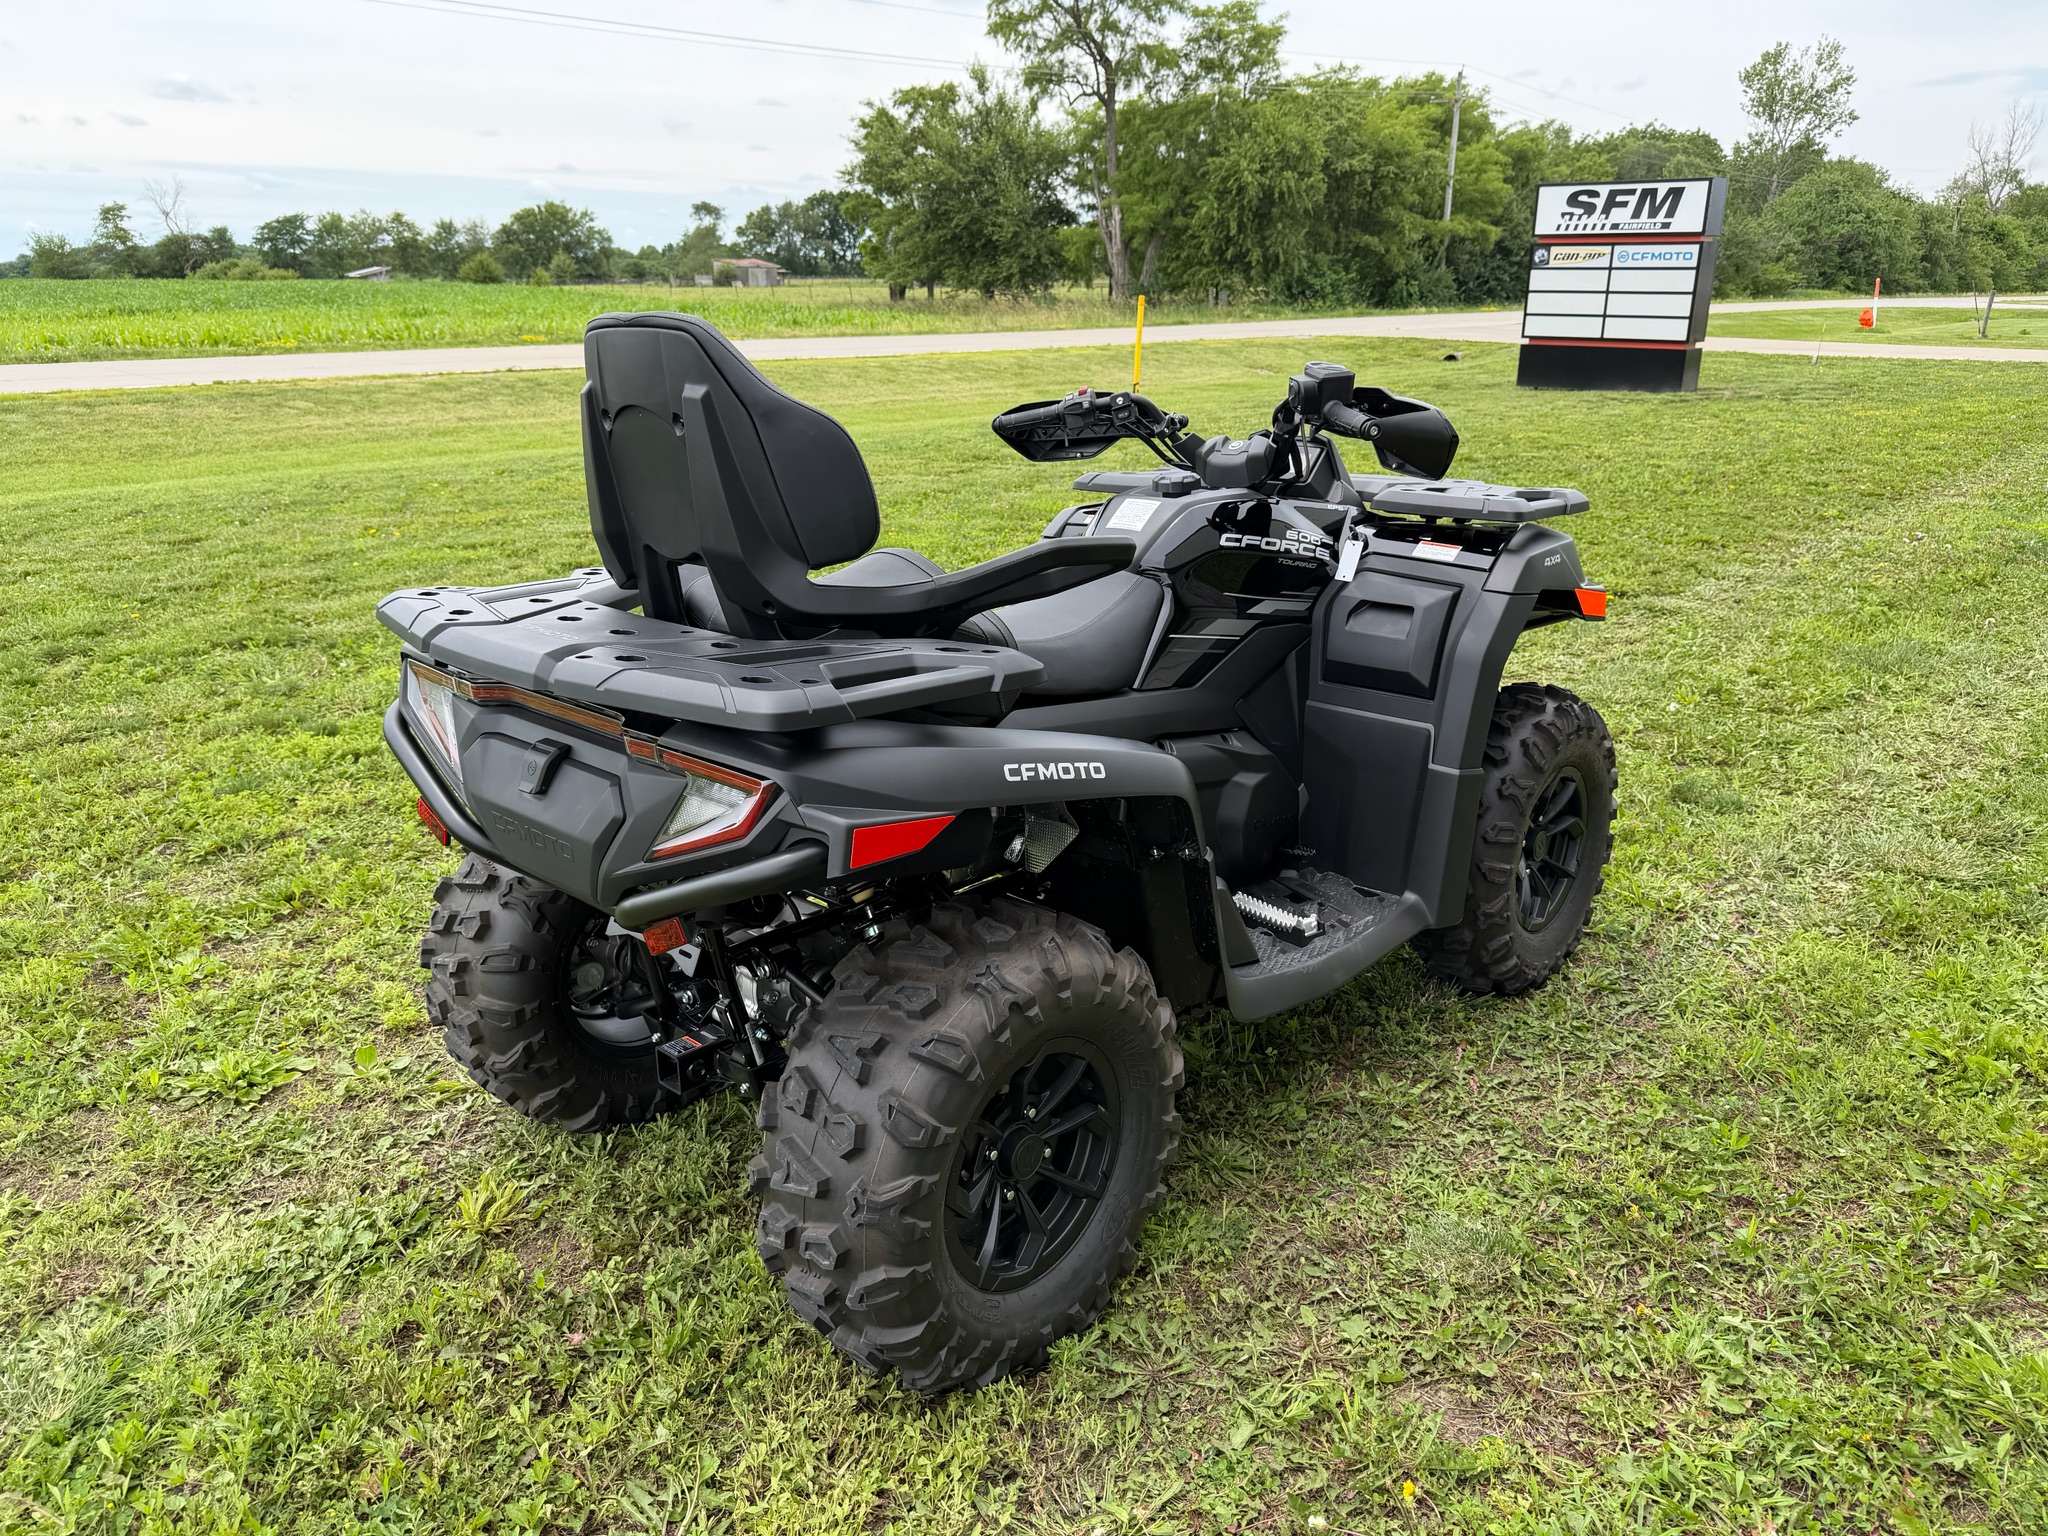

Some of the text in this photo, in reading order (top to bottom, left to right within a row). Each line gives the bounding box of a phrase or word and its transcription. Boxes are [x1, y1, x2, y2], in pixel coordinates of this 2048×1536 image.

[1560, 186, 1687, 222] SFM
[1618, 222, 1662, 230] FAIRFIELD
[1631, 251, 1693, 262] CFMOTO
[1219, 533, 1331, 561] CFORCE
[1286, 530, 1322, 546] 600
[1277, 557, 1319, 569] TOURING
[1003, 762, 1106, 782] CFMOTO
[491, 810, 575, 863] CFMOTO
